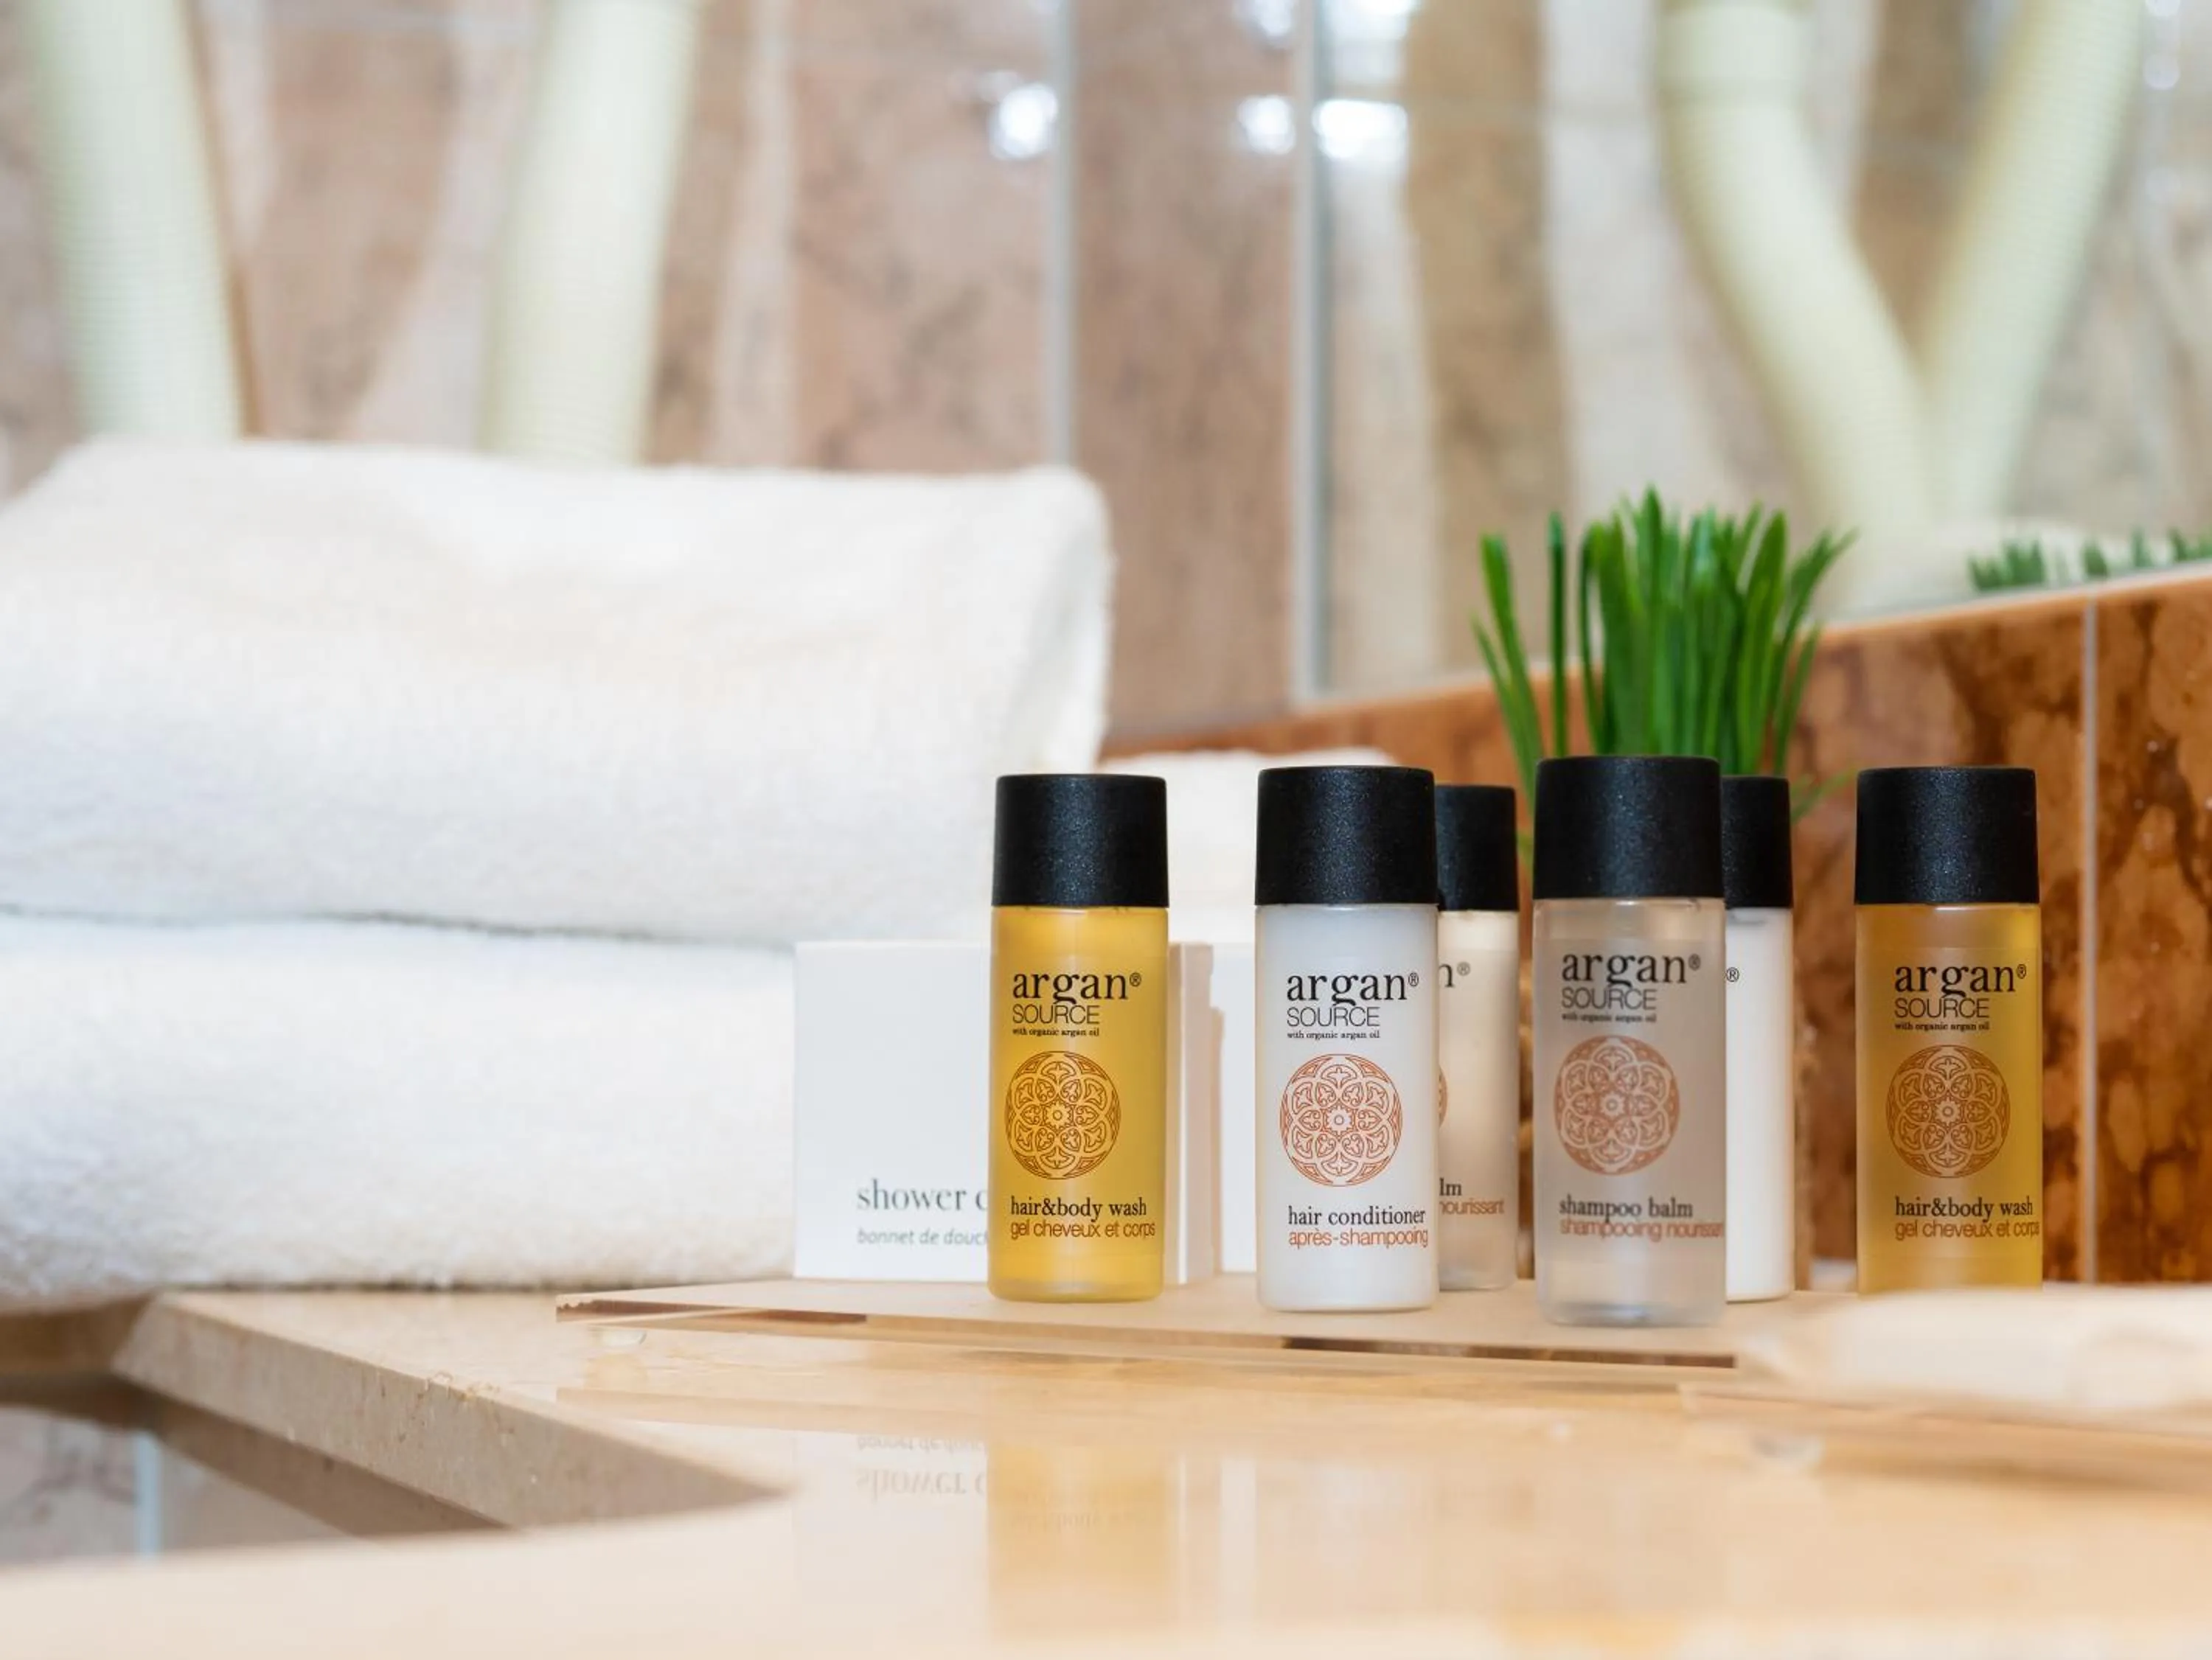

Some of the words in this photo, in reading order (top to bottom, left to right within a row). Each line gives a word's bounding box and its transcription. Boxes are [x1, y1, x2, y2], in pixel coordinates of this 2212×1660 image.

[1561, 987, 1657, 1010] SOURCE
[1895, 997, 1990, 1019] SOURCE
[1012, 1004, 1100, 1025] SOURCE
[1287, 1006, 1380, 1027] SOURCE
[1012, 1028, 1027, 1036] with
[1029, 1028, 1060, 1037] organic
[1061, 1029, 1086, 1038] argan
[1088, 1028, 1099, 1036] oil
[1287, 1030, 1304, 1039] with
[1306, 1030, 1338, 1040] organic
[1340, 1031, 1367, 1040] argan
[1369, 1030, 1380, 1039] oil
[1894, 1021, 1913, 1030] with
[1916, 1022, 1948, 1031] organic
[1950, 1022, 1977, 1032] argan
[1978, 1022, 1990, 1030] oil
[857, 1178, 967, 1211] shower
[1439, 1177, 1461, 1196] lm
[1011, 1196, 1103, 1222] hair&body
[1108, 1197, 1147, 1216] wash
[1288, 1205, 1322, 1225] hair
[1328, 1205, 1426, 1225] conditioner
[1559, 1193, 1642, 1223] shampoo
[1648, 1196, 1694, 1218] balm
[1895, 1196, 1994, 1222] hair&body
[1999, 1196, 2034, 1216] wash
[857, 1227, 916, 1245] bonnet
[919, 1227, 940, 1245] de
[1011, 1219, 1030, 1240] gel
[1033, 1220, 1101, 1238] cheveux
[1105, 1221, 1120, 1237] et
[1123, 1222, 1155, 1239] corps
[1288, 1228, 1428, 1249] après-shampooing
[1560, 1218, 1662, 1242] shampooing
[1895, 1220, 1917, 1241] gel
[1922, 1220, 1994, 1238] cheveux
[1996, 1221, 2011, 1237] et
